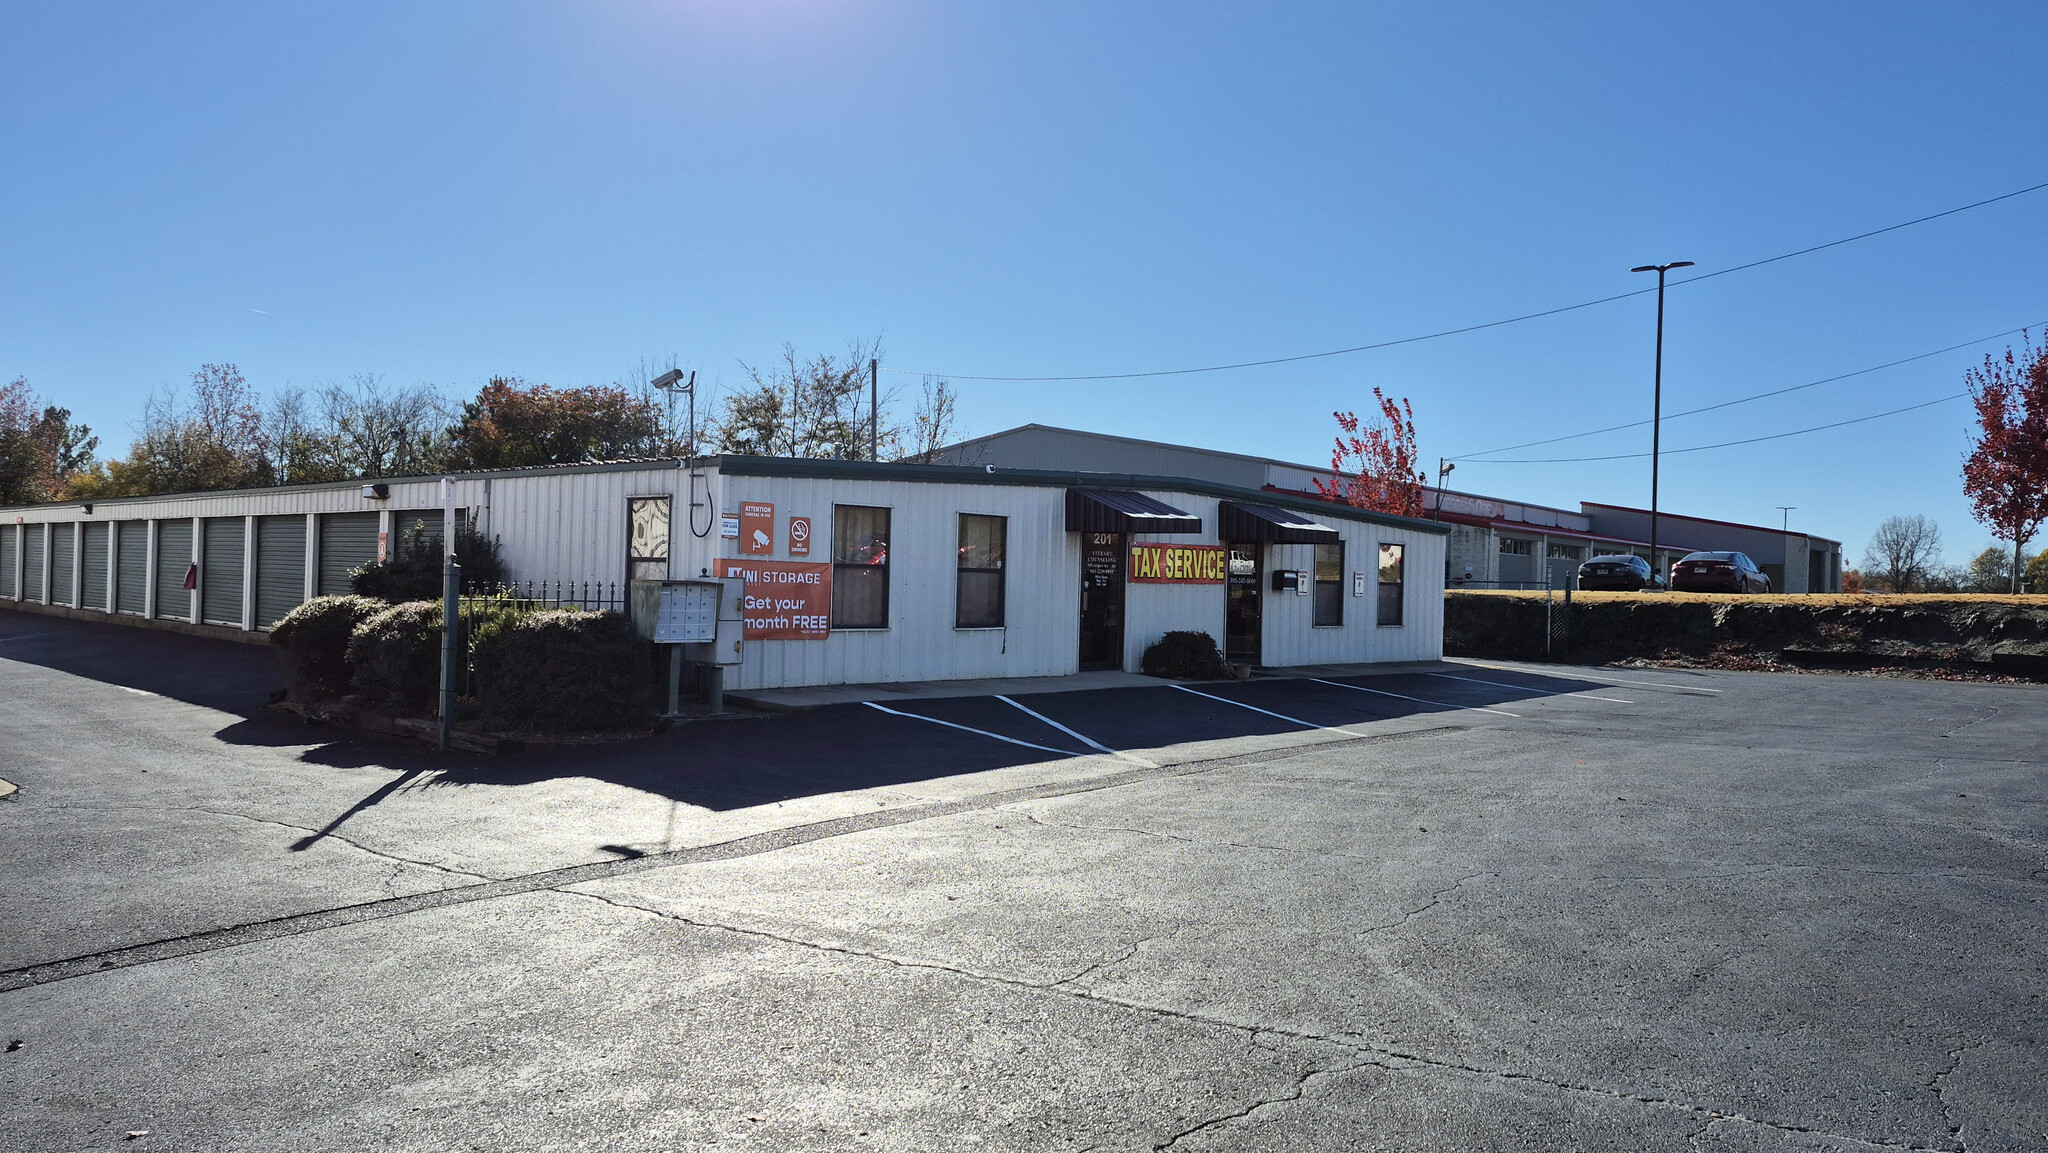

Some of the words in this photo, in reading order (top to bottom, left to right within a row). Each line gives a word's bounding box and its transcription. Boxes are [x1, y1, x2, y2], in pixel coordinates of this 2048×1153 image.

[1094, 533, 1112, 545] 201
[1131, 547, 1161, 578] TAX
[1165, 548, 1225, 580] SERVICE
[763, 571, 821, 585] STORAGE
[744, 595, 771, 610] Get
[774, 599, 805, 613] your
[744, 615, 788, 629] month
[792, 615, 827, 629] FREE
